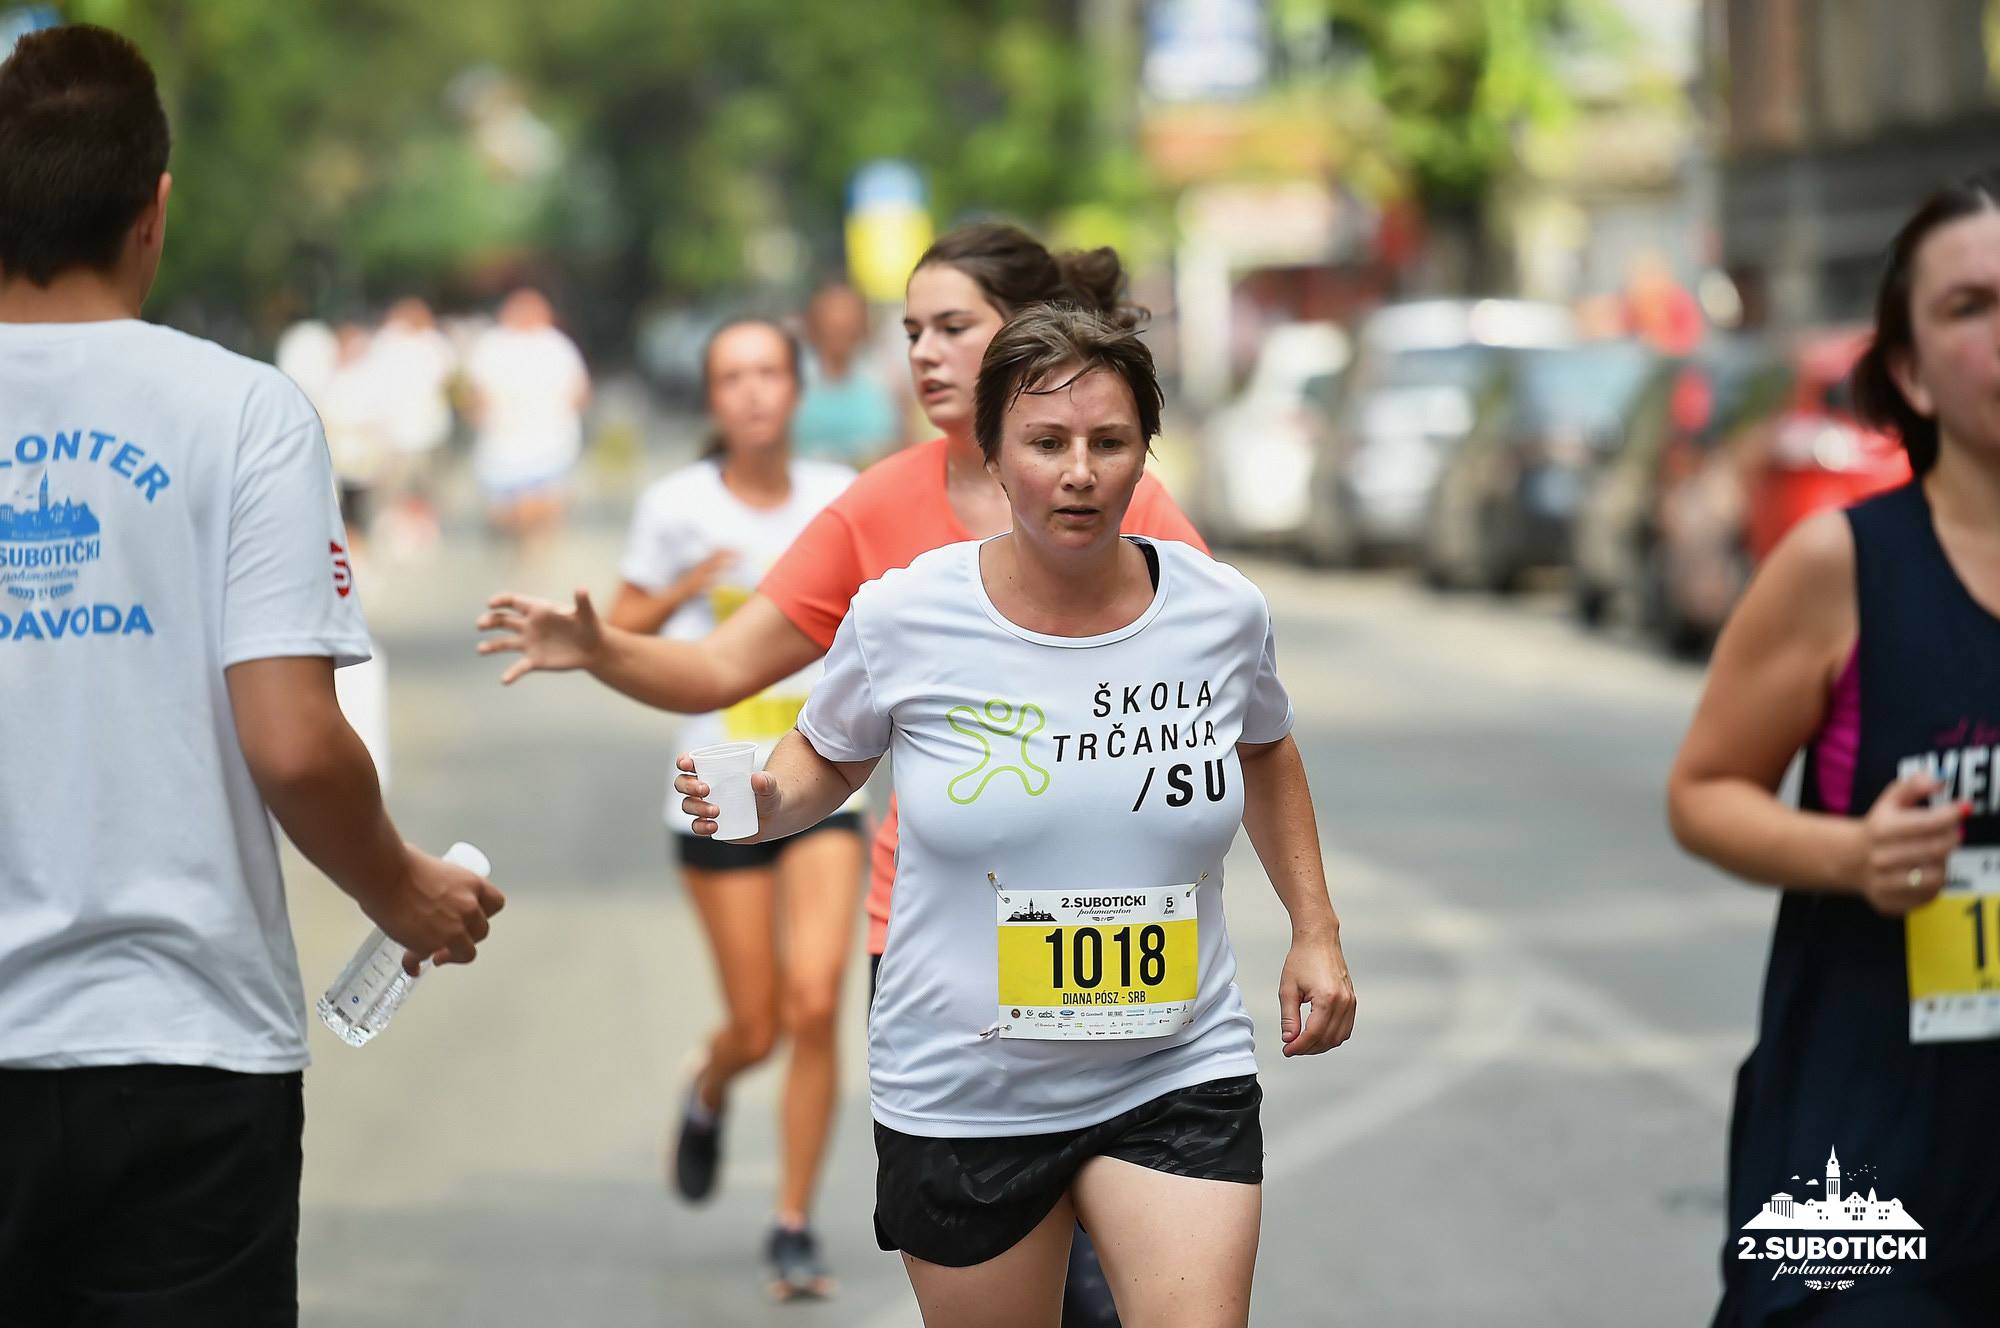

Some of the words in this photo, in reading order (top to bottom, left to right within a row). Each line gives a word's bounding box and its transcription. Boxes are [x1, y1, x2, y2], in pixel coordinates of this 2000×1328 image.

[1093, 681, 1212, 718] ŠKOLA
[1053, 721, 1216, 763] TRČANJA
[1132, 758, 1226, 813] /SU
[1165, 896, 1174, 908] 5
[1965, 898, 2000, 970] 1
[1045, 924, 1166, 989] 1018
[1062, 992, 1093, 1005] DIANA
[1095, 990, 1119, 1004] PÓSZ
[1128, 991, 1146, 1003] SRB
